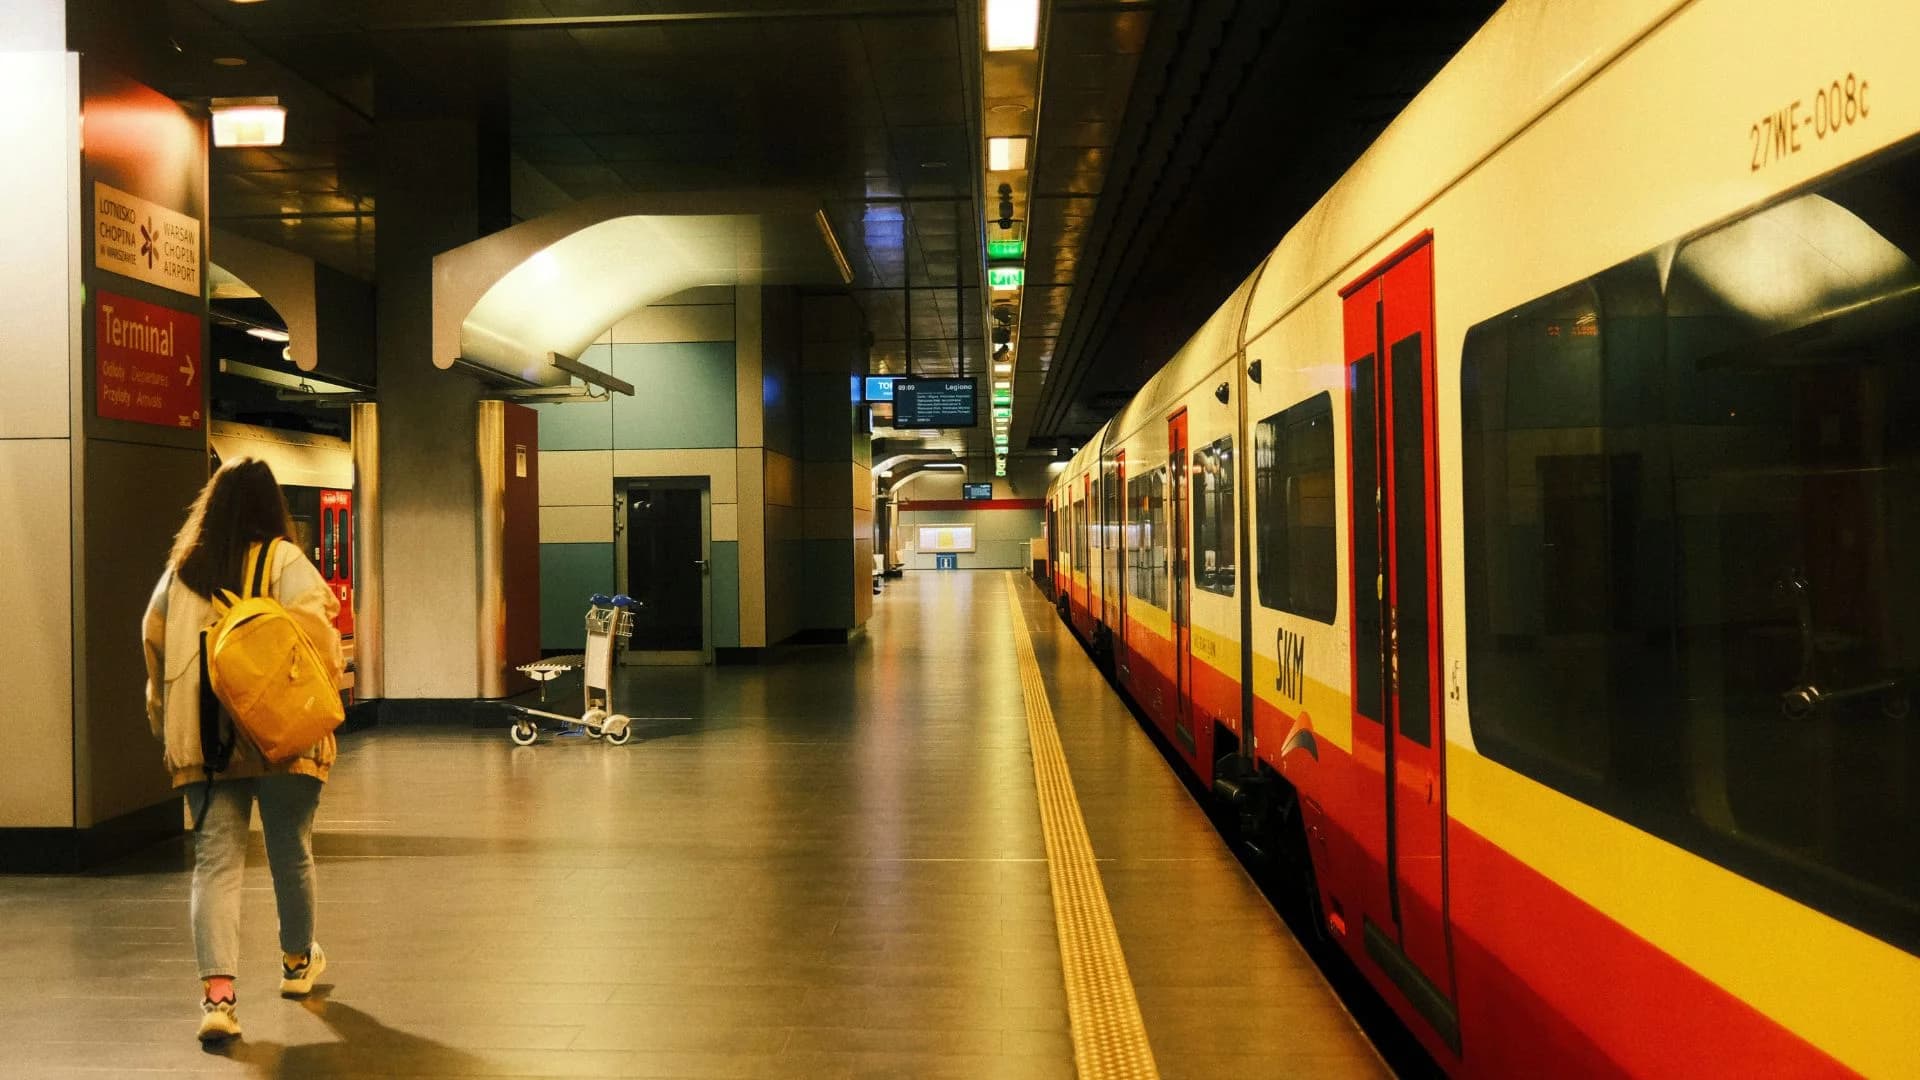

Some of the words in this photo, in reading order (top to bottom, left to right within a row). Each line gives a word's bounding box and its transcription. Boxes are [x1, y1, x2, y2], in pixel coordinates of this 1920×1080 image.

[1750, 72, 1869, 171] 27WE-008c
[100, 199, 136, 225] LOTNISKO
[100, 222, 136, 248] CHOPINA
[163, 222, 195, 245] WARSAW
[164, 242, 195, 264] CHOPIN
[164, 261, 196, 283] AIRPORT
[102, 304, 174, 357] Terminal
[136, 392, 162, 409] Arrivals
[1276, 627, 1304, 705] SKM
